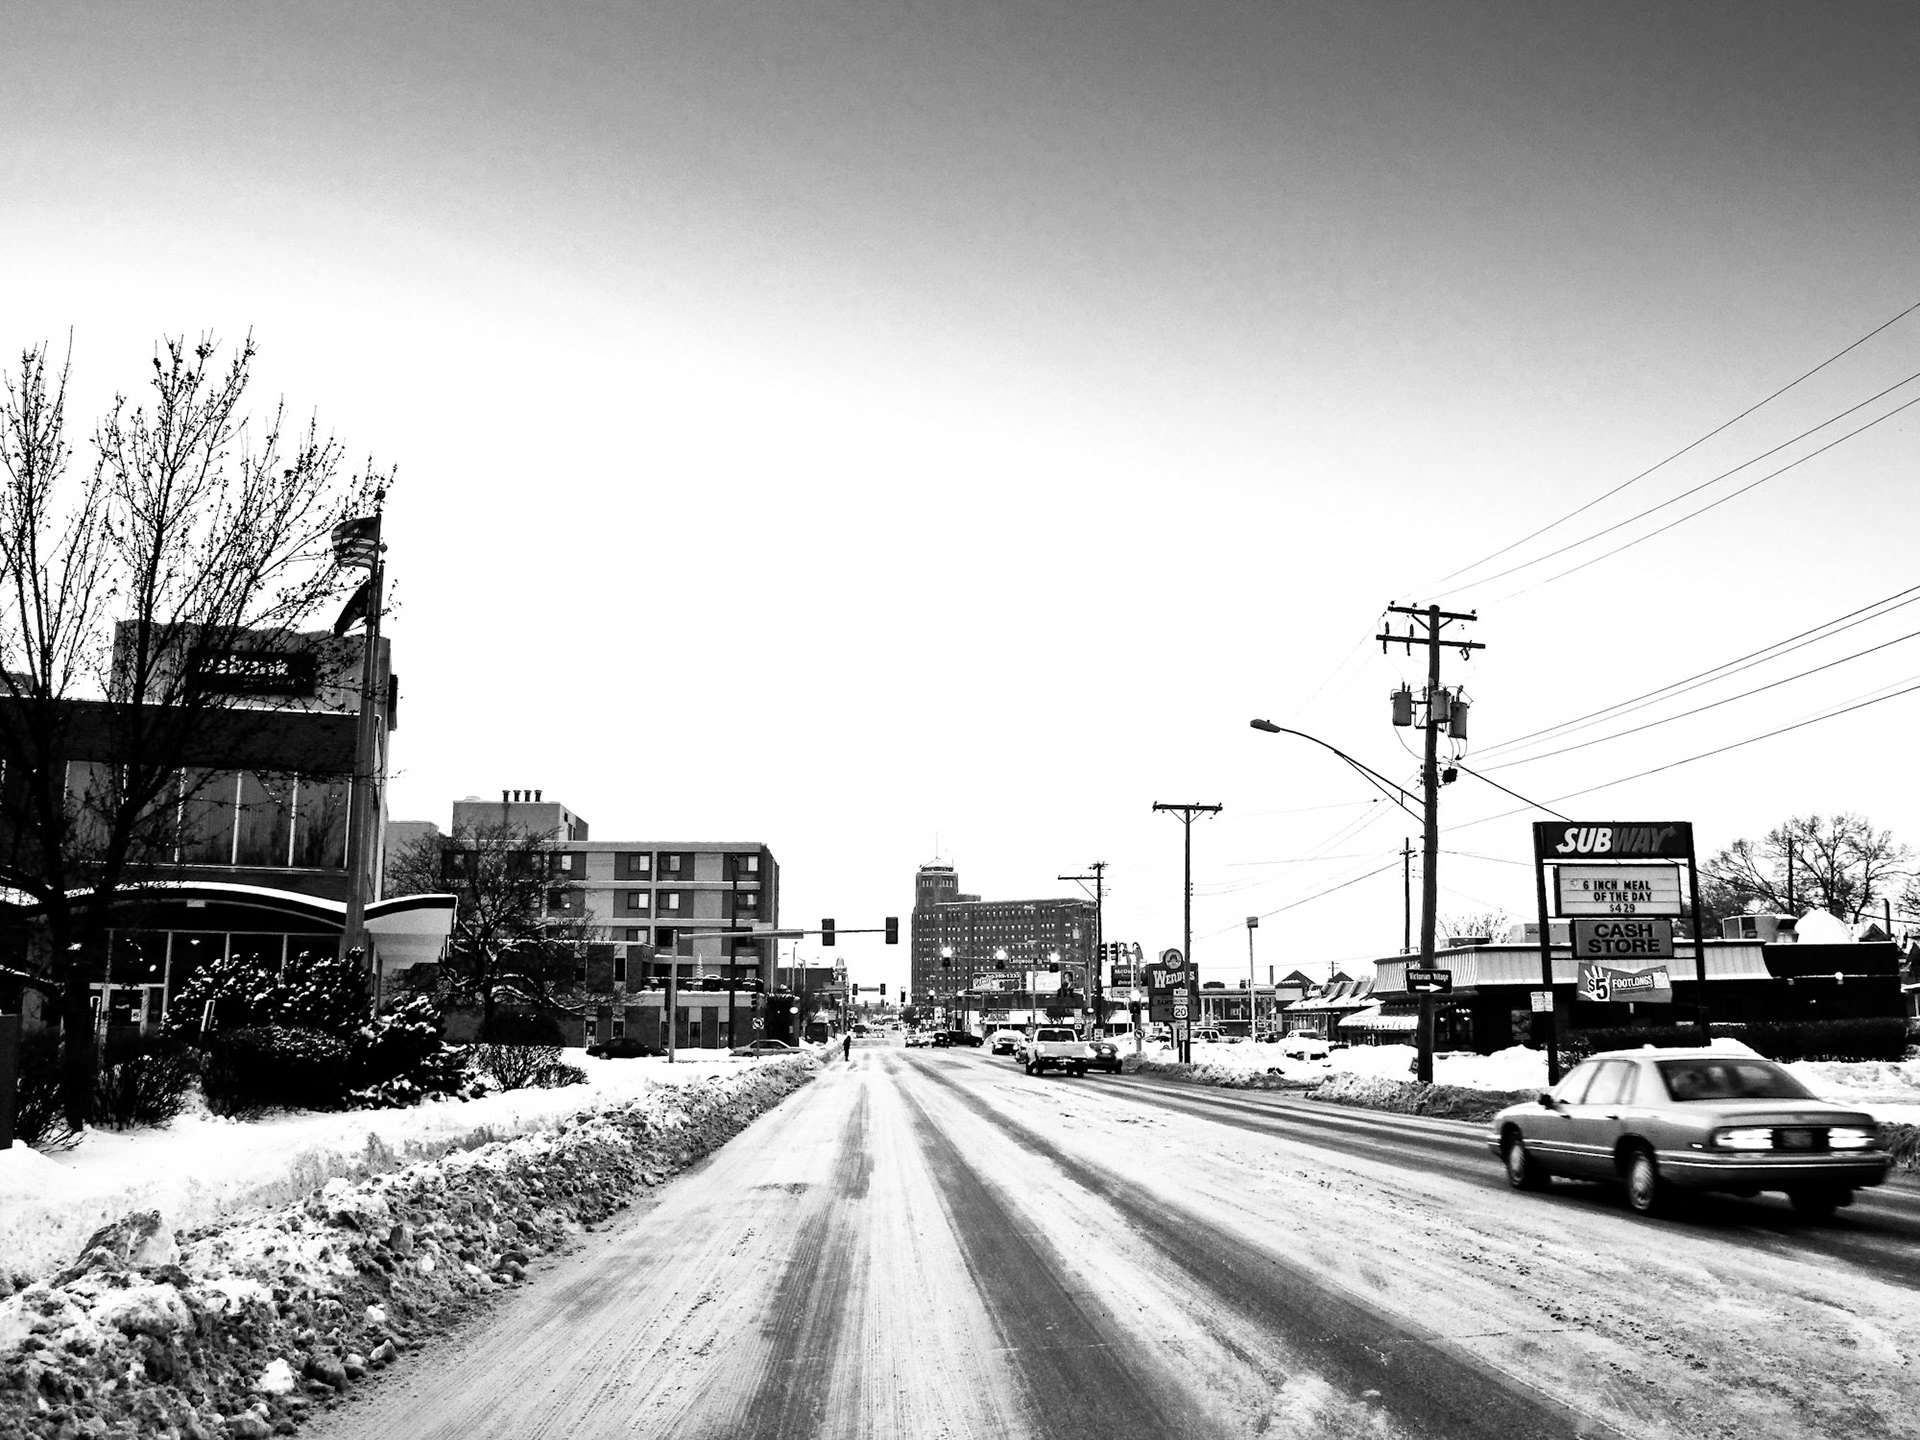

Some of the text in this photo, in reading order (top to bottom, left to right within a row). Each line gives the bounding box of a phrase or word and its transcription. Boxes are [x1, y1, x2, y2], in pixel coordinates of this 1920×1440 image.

[1556, 827, 1676, 854] SUBWAY
[1583, 880, 1652, 891] 6 INCH MEAL
[1593, 891, 1652, 902] OF THE DAY
[1594, 923, 1654, 938] CASH
[1588, 938, 1661, 954] STORE
[1432, 972, 1449, 983] Village
[1588, 975, 1653, 1000] $5 FOOTLONGS
[1174, 1007, 1187, 1017] 20
